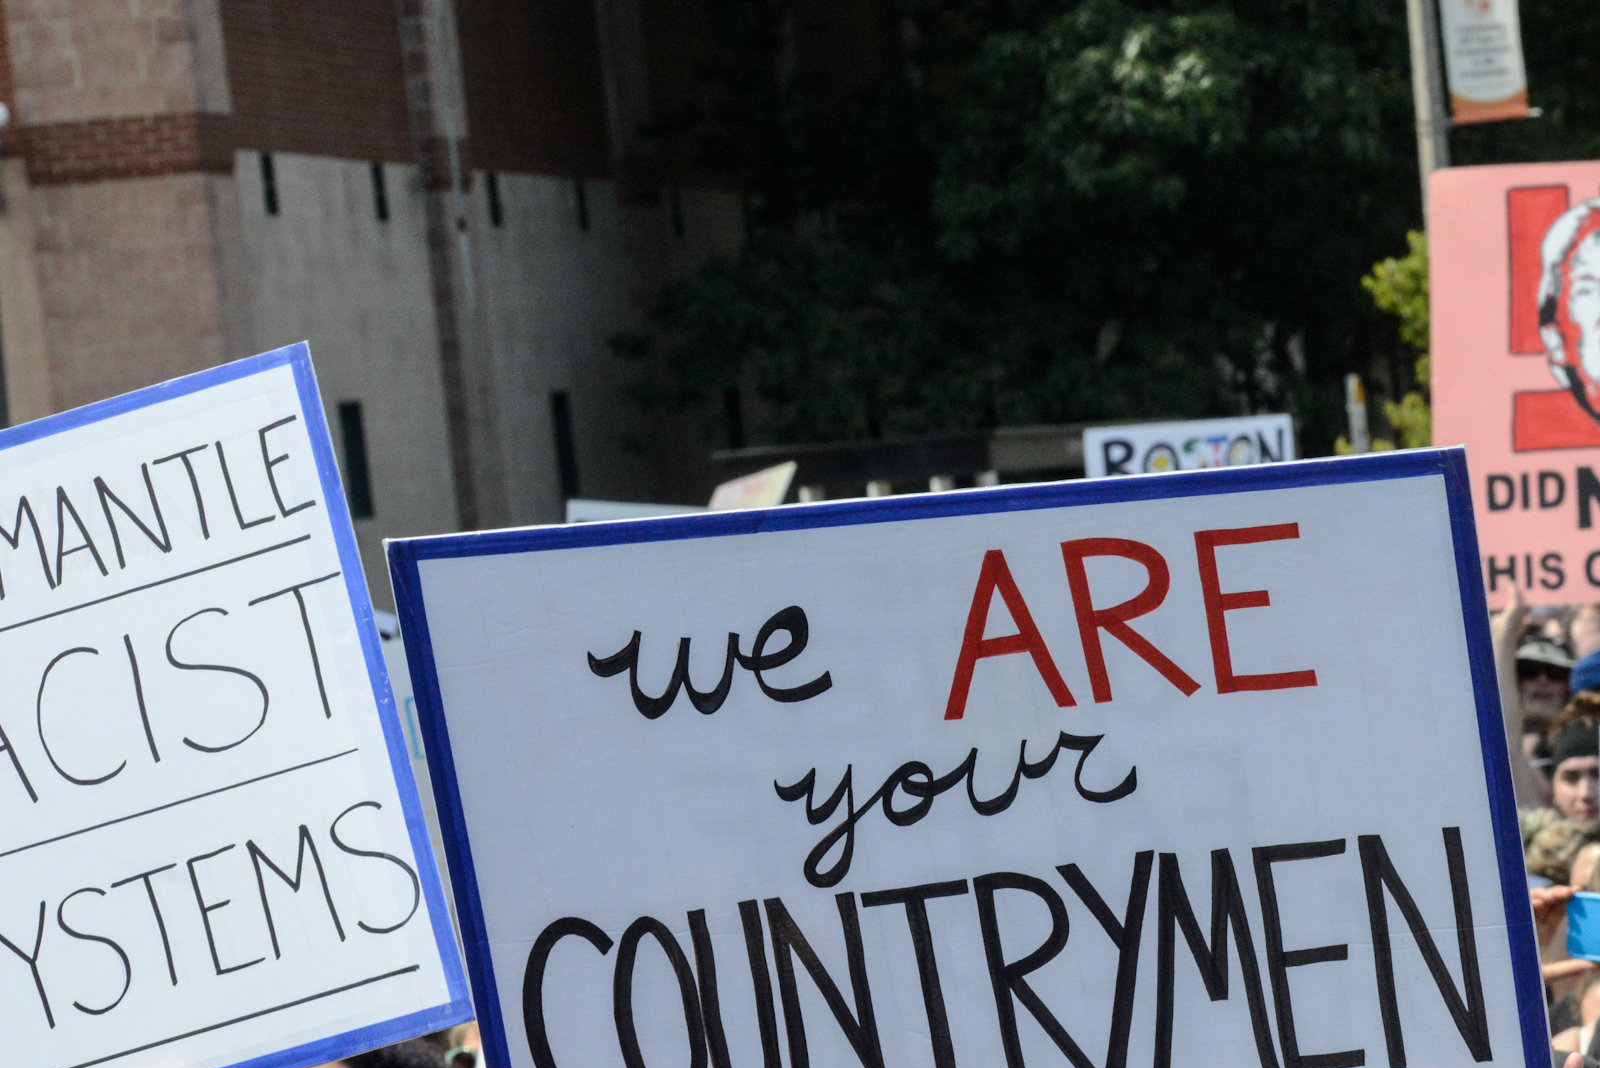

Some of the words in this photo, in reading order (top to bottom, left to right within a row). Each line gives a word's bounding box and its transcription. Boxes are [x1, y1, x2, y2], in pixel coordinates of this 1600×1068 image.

[0, 415, 316, 598] MANTLE
[1486, 471, 1566, 513] DID
[587, 604, 833, 720] we
[944, 521, 1318, 722] ARE
[1484, 552, 1567, 592] HIS
[774, 729, 1138, 888] your
